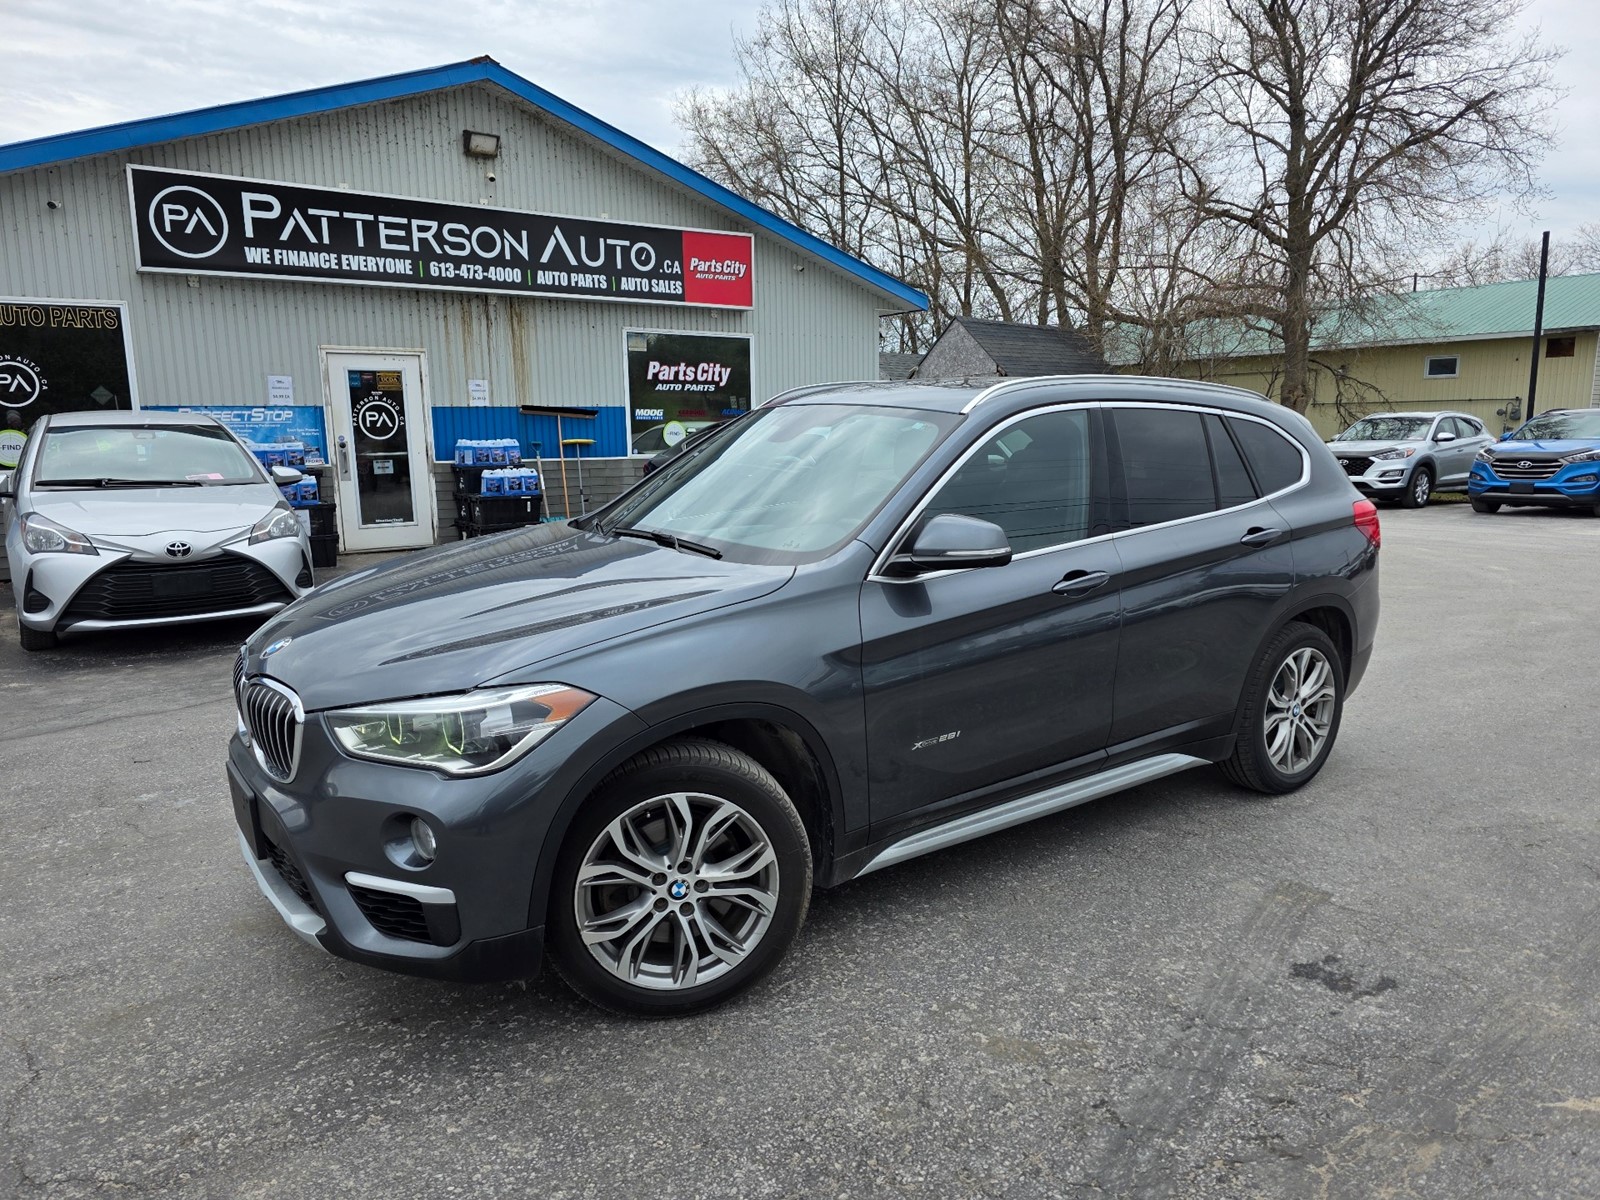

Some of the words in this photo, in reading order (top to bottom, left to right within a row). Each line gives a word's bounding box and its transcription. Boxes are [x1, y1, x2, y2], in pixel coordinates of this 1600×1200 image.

[162, 203, 218, 236] PA
[241, 191, 529, 262] PATTERSON
[539, 224, 656, 272] AUTO
[244, 246, 271, 264] WE
[274, 248, 339, 270] FINANCE
[341, 254, 413, 275] EVERYONE
[429, 261, 522, 283] 613-473-4000
[536, 270, 568, 287] AUTO
[570, 273, 607, 289] PARTS
[620, 276, 649, 292] AUTO
[651, 278, 683, 295] SALES
[0, 304, 45, 327] UTO
[51, 306, 118, 329] PARTS
[16, 356, 41, 373] AUTO
[655, 383, 682, 391] AUTO
[684, 384, 715, 392] PARTS
[179, 408, 293, 421] FECTSTOP
[352, 395, 379, 426] PATTERSON
[382, 396, 400, 411] AUTO
[365, 411, 393, 427] PA
[635, 408, 664, 417] MOOG
